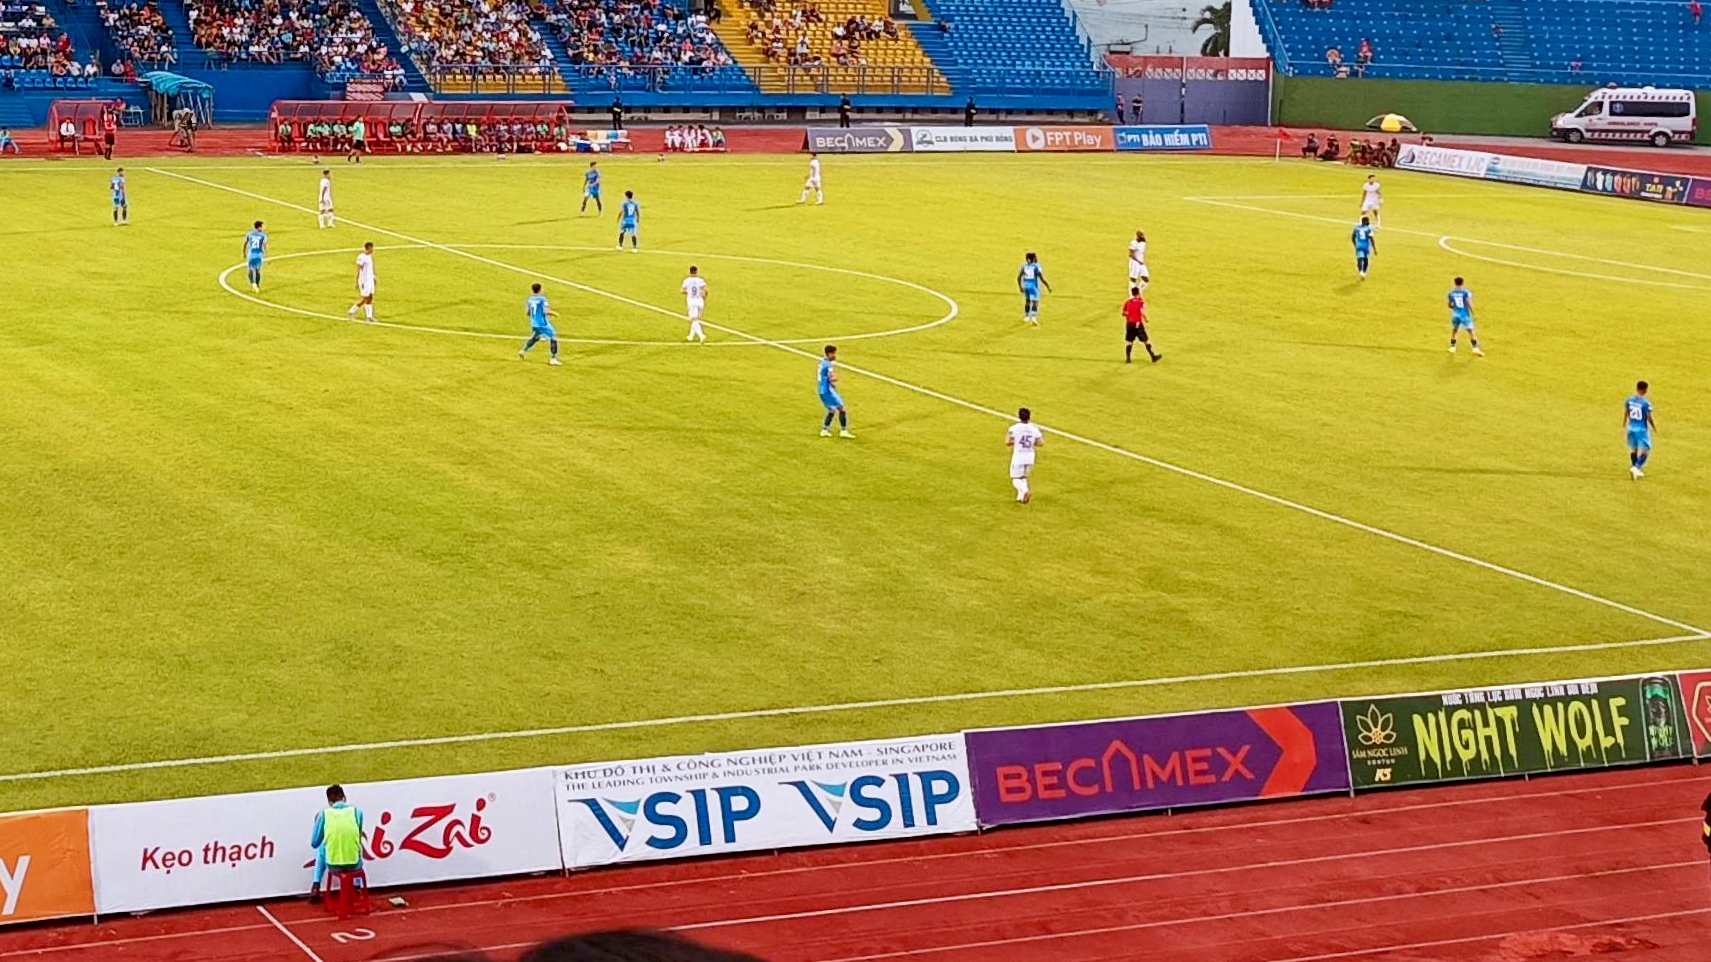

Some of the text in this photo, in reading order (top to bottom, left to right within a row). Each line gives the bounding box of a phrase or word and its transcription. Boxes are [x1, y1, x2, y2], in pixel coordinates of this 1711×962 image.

[816, 133, 888, 150] BECAMEX
[1046, 130, 1102, 148] FPT Play
[1415, 145, 1464, 170] BECAMEX
[1019, 435, 1032, 448] 45
[1412, 696, 1630, 777] NIGHT WOLF
[564, 769, 597, 781] KHU
[632, 765, 656, 776] THỊ
[661, 763, 672, 772] &
[676, 759, 722, 771] CÔNG
[726, 750, 787, 767] NGHIỆP
[791, 748, 824, 764] VIỆT
[829, 749, 863, 760] NAM
[876, 741, 956, 757] SINGAPORE
[591, 778, 645, 790] LEADING
[649, 772, 708, 785] TOWNSHIP
[711, 771, 719, 779] &
[723, 766, 791, 778] INDUSTRIAL
[794, 763, 822, 773] PARK
[825, 759, 888, 771] DEVELOPER
[891, 757, 901, 765] IN
[907, 753, 957, 765] VIETNAM
[996, 739, 1256, 803] BECAMEX
[567, 769, 961, 853] VSIP VSIP
[141, 846, 193, 875] Kẹo
[202, 835, 275, 869] thạch
